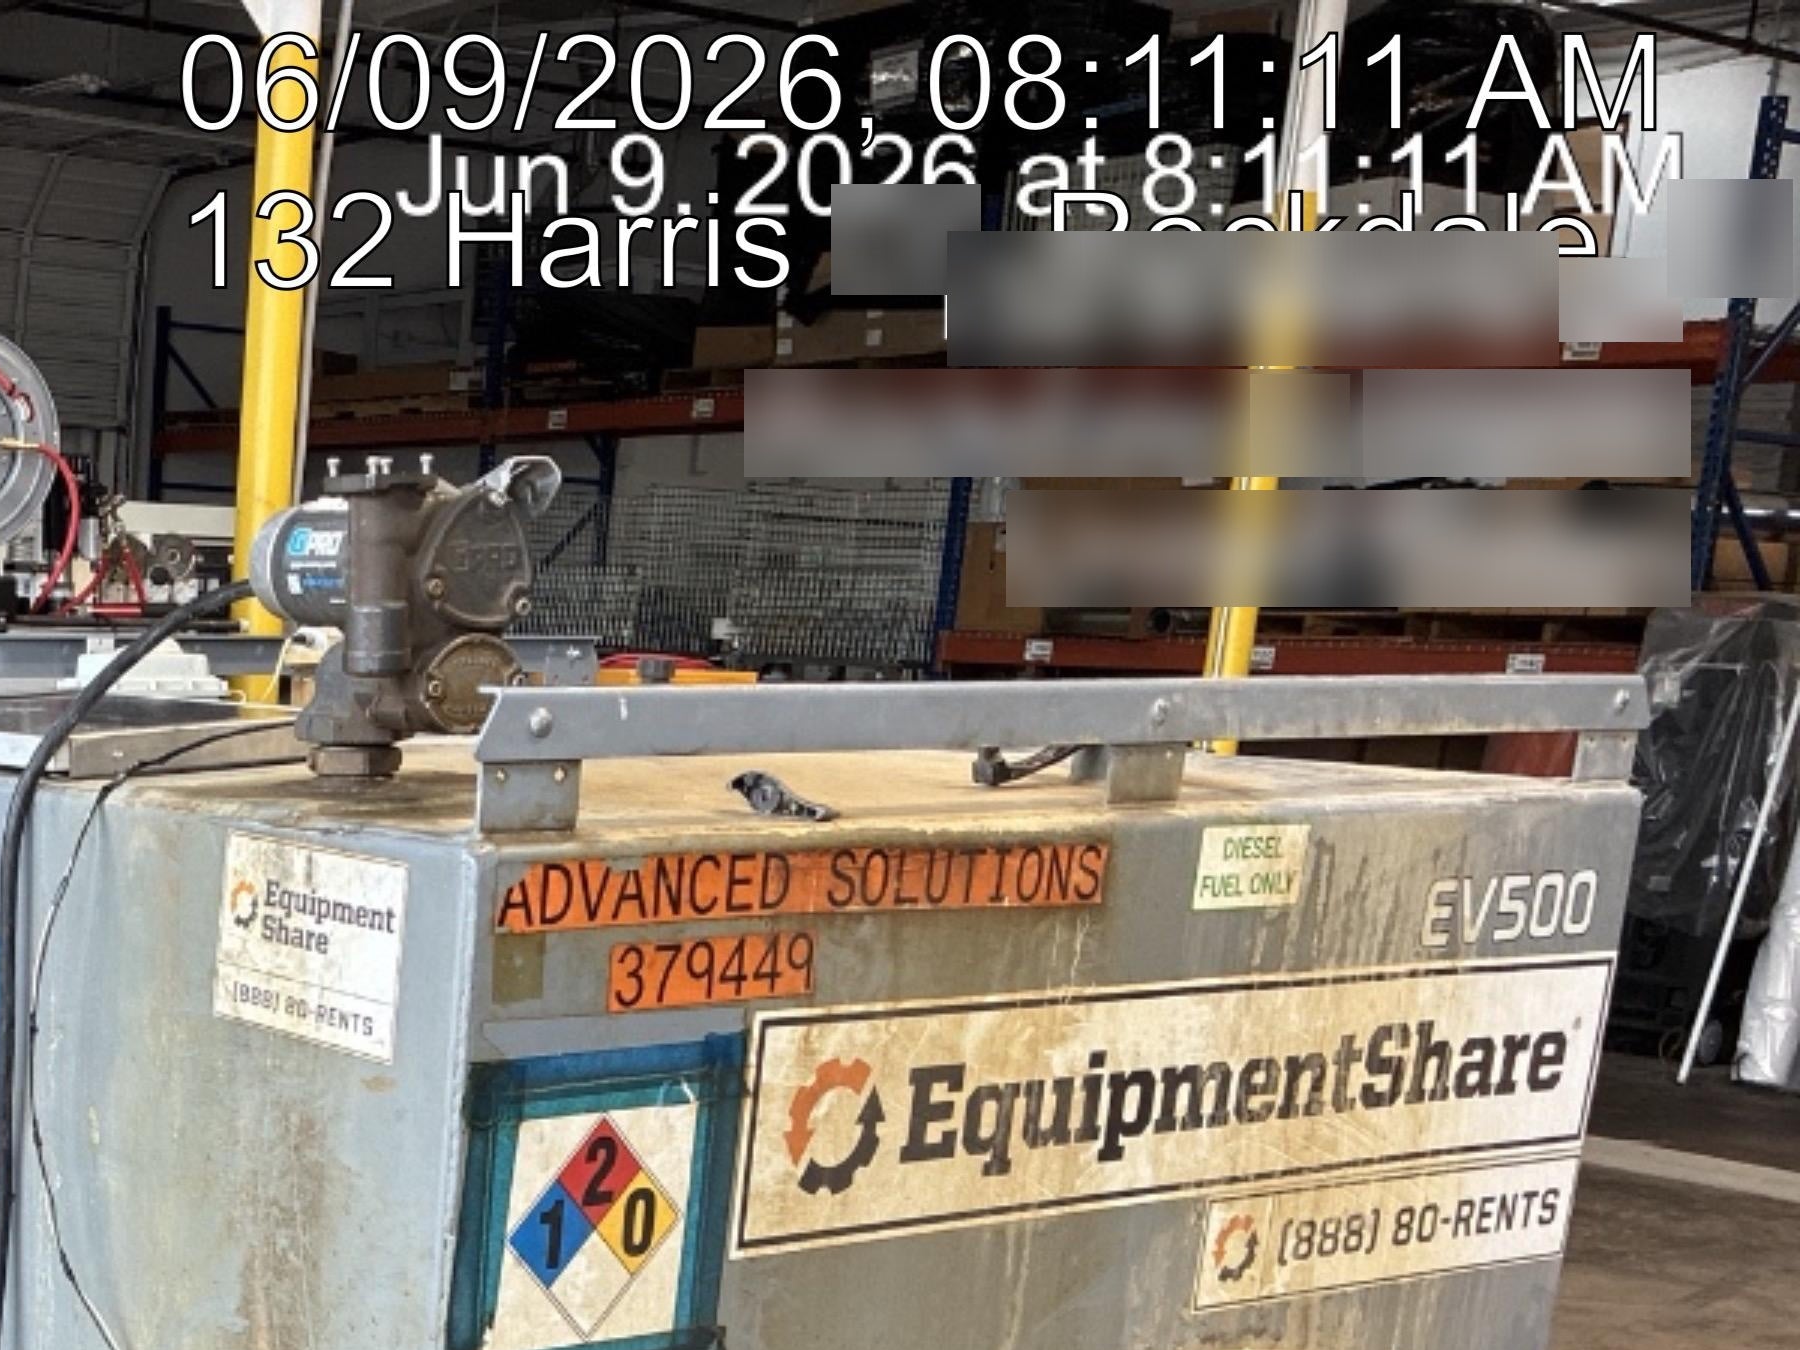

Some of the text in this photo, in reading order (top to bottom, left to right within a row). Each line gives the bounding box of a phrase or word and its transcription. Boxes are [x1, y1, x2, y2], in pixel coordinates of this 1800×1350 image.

[1223, 835, 1284, 861] DIESEL
[263, 879, 396, 934] Equipment
[497, 844, 1102, 928] ADVANCED SOLUTIONS
[1200, 871, 1296, 898] FUEL ONLY
[1420, 867, 1599, 949] EV500
[261, 914, 330, 955] Share
[614, 932, 813, 1007] 379449
[898, 1017, 1569, 1177] EquipmentShare
[581, 1136, 618, 1207] 2
[539, 1199, 565, 1270] 1
[622, 1187, 657, 1258] 0
[1276, 1187, 1561, 1266] (888) 80-RENTS
